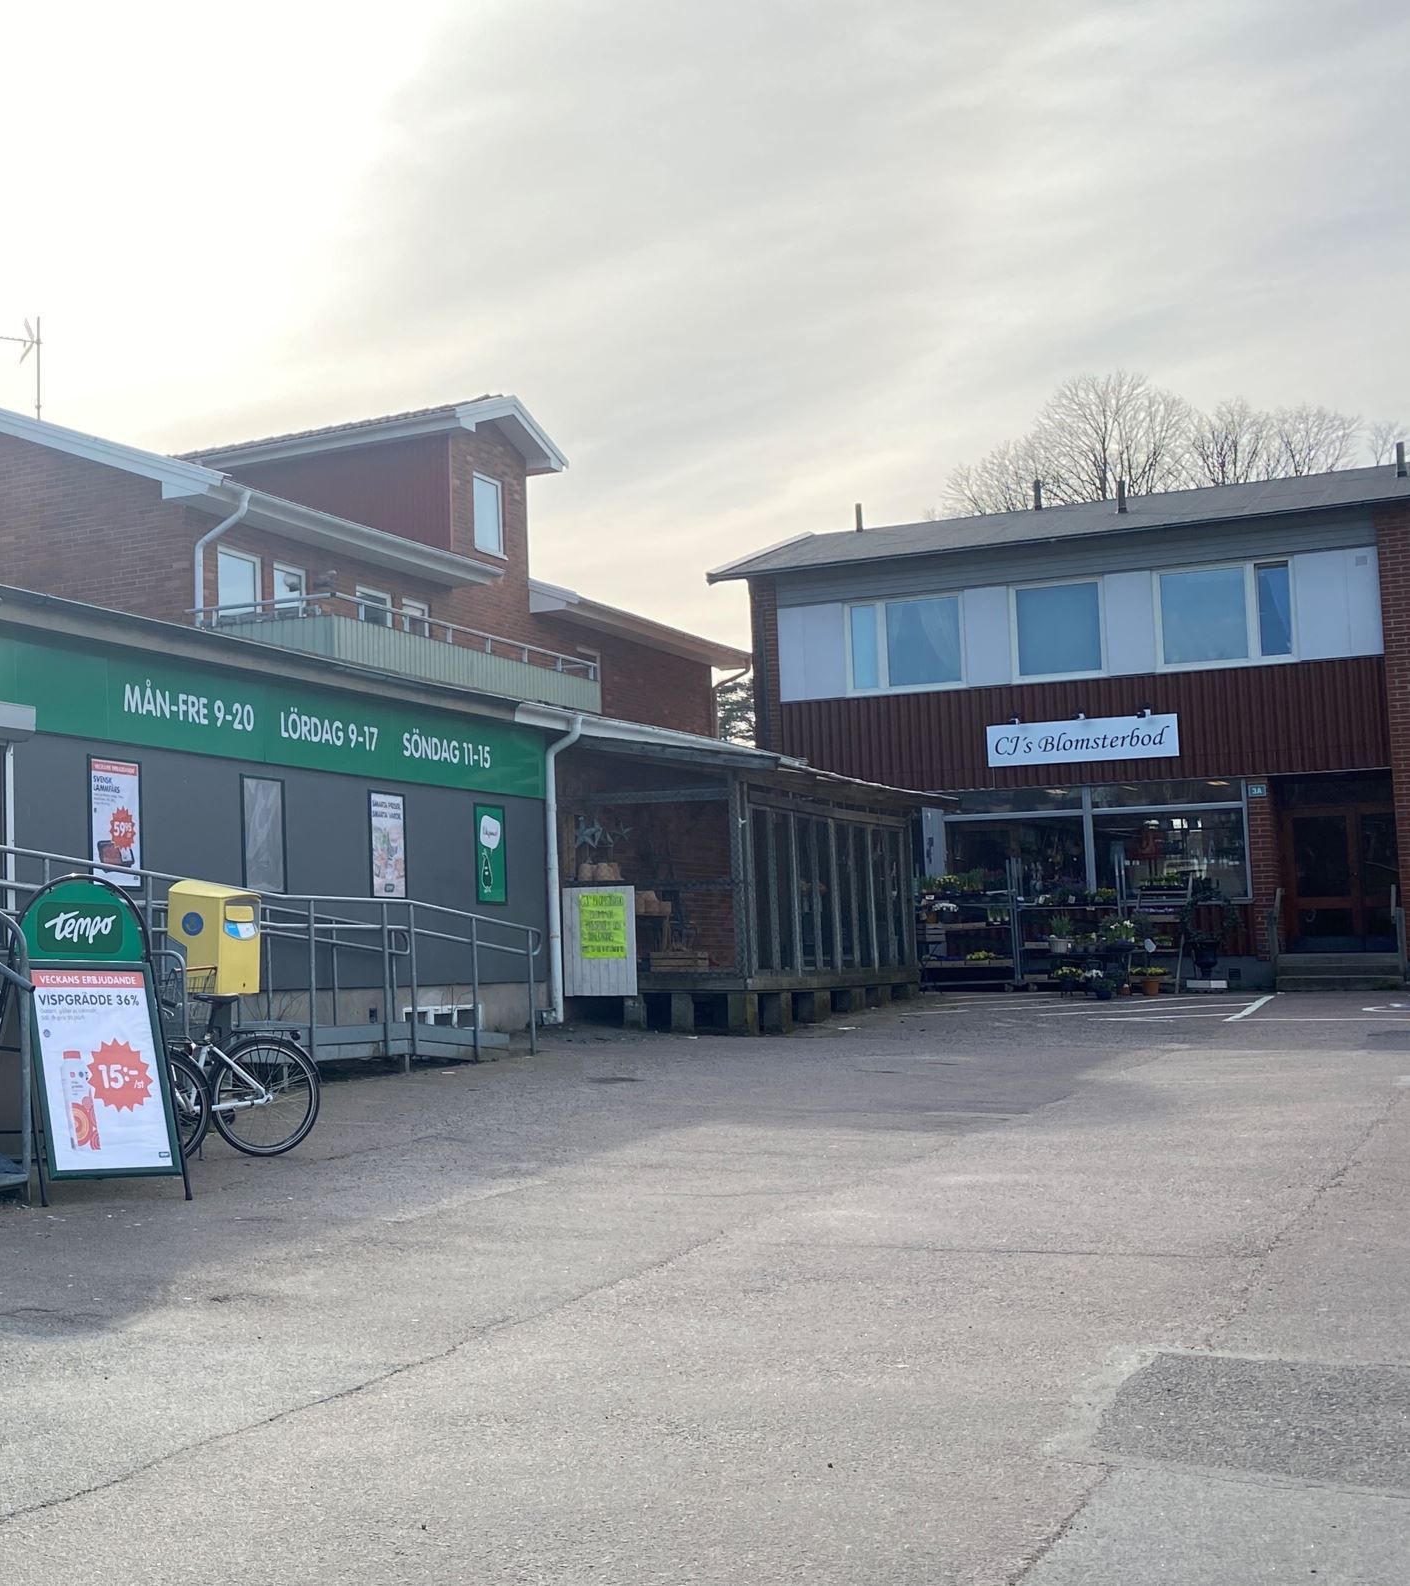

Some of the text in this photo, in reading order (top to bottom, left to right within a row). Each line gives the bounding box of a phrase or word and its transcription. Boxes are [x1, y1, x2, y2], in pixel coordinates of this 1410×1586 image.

[123, 678, 255, 732] MÅN-FRE 9-20
[280, 706, 378, 751] LÖRDAG 9-17
[1037, 725, 1170, 753] Blomsterbod
[402, 727, 491, 768] SÖNDAG 11-15
[39, 975, 137, 985] VECKANS ERBJUDANDE
[38, 991, 139, 1006] VISPGRÄDDE 36%
[98, 1064, 139, 1089] 15:-
